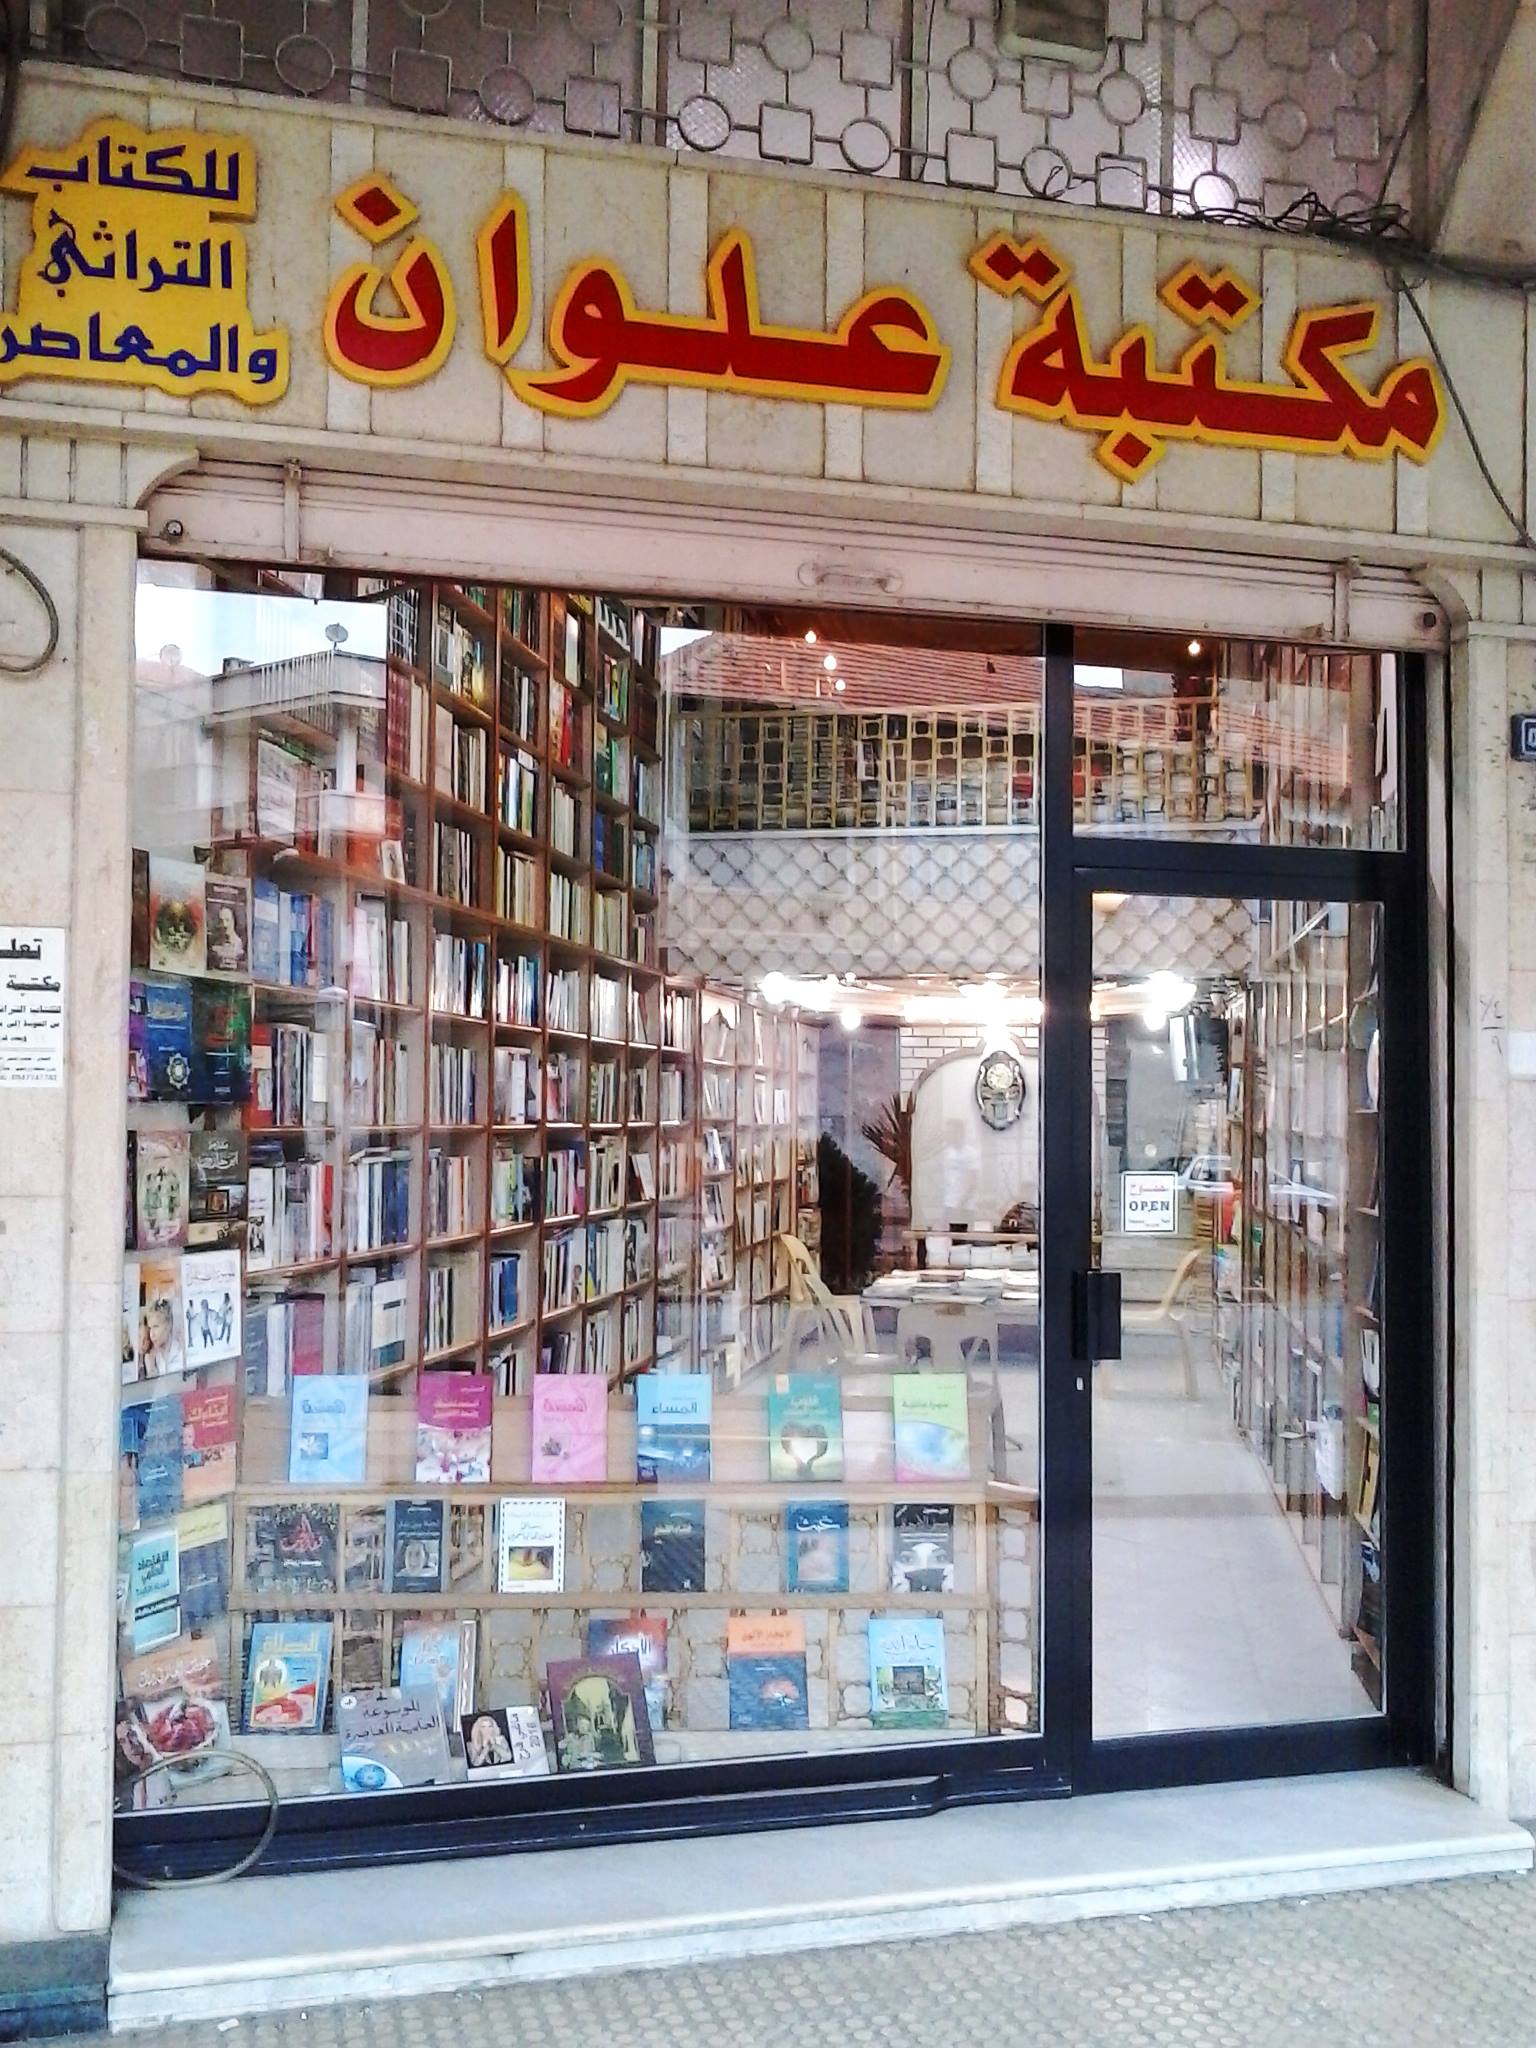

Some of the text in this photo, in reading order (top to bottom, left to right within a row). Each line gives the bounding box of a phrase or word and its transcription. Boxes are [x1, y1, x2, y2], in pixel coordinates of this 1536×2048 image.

[25, 135, 240, 201] للكتاب
[37, 208, 233, 298] التراثي
[0, 311, 278, 384] والمعاصر
[333, 186, 1439, 469] مكتبة علوان
[6, 974, 61, 997] مكتبة
[1129, 1200, 1170, 1212] OPEN
[651, 1402, 698, 1415] المساء
